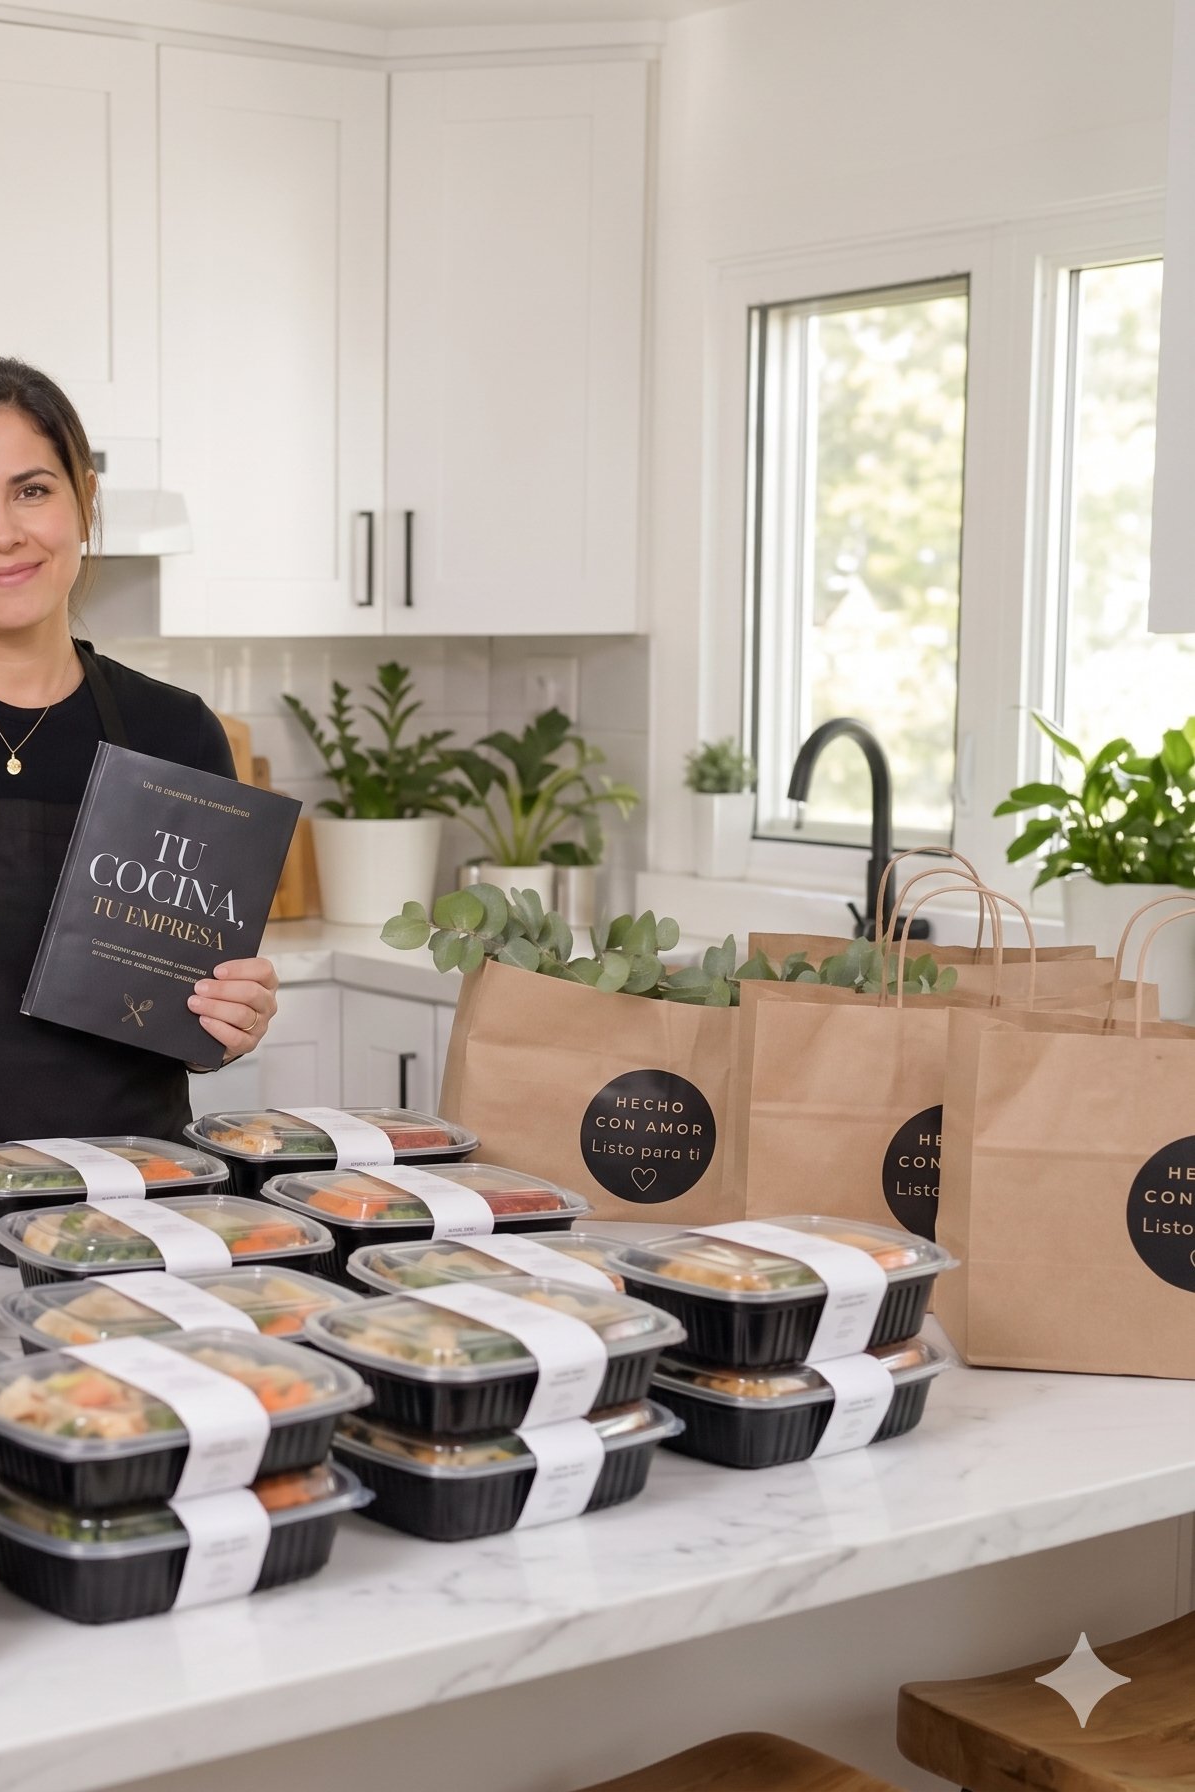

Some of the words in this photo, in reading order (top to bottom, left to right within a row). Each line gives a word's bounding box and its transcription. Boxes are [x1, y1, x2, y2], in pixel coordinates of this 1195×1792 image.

[154, 829, 209, 872] TU
[89, 852, 245, 931] COCINA,
[92, 895, 124, 920] TU
[124, 905, 225, 951] EMPRESA
[616, 1096, 684, 1114] HECHO
[595, 1116, 635, 1131] CON
[645, 1121, 703, 1136] AMOR
[591, 1138, 635, 1156] Listo
[641, 1147, 681, 1160] para
[689, 1148, 700, 1161] ti
[898, 1155, 941, 1169] CON
[1168, 1166, 1195, 1181] HE
[1144, 1189, 1193, 1206] CON
[1142, 1217, 1194, 1236] Listo
